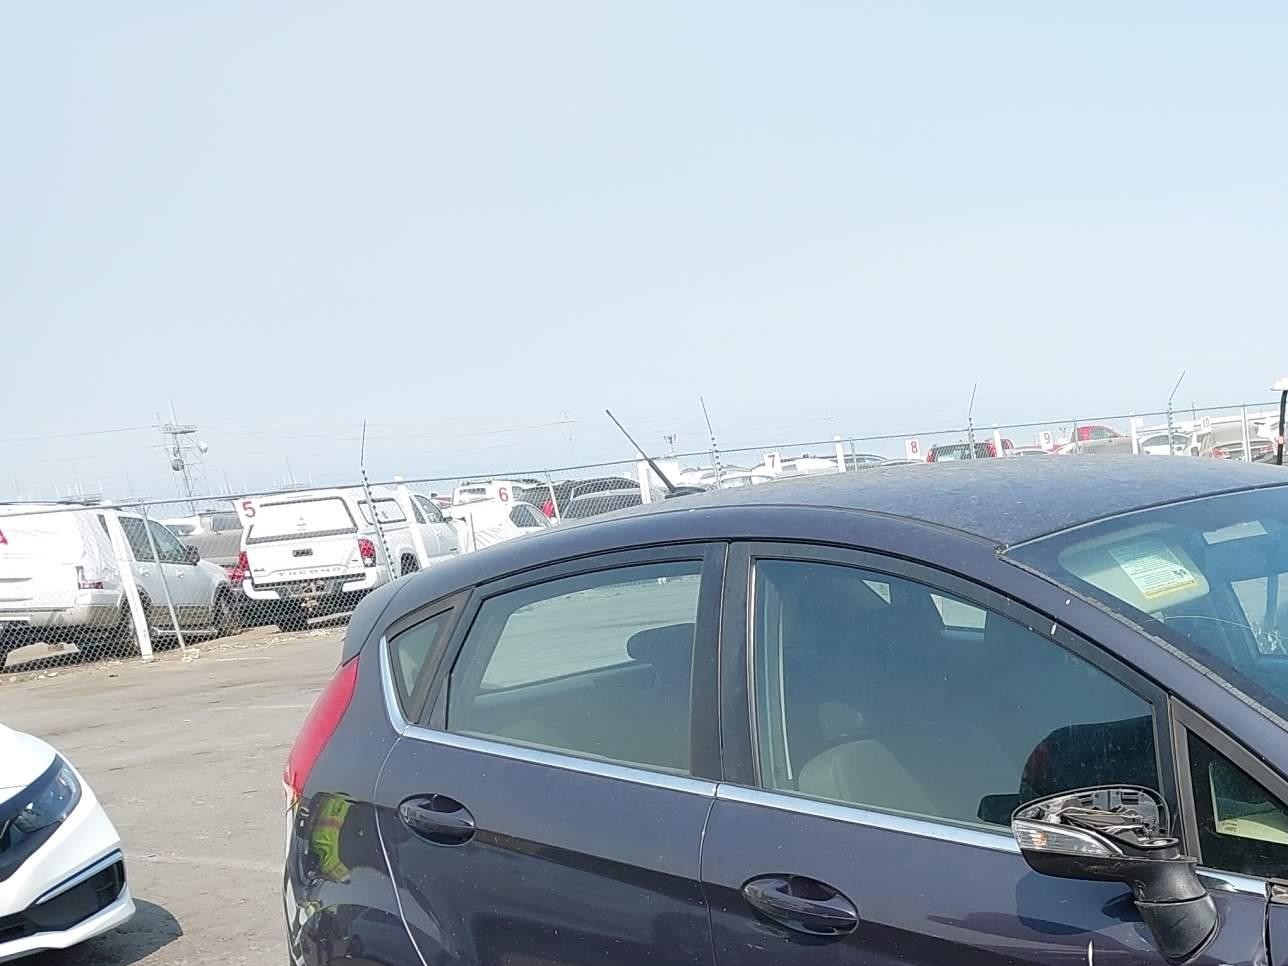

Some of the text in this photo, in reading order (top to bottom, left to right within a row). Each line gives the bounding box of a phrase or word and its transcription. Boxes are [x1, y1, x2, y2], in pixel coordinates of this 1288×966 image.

[1043, 432, 1051, 445] 9
[911, 440, 918, 454] 8
[767, 454, 776, 469] 7
[498, 486, 509, 502] 6
[241, 500, 256, 518] 5
